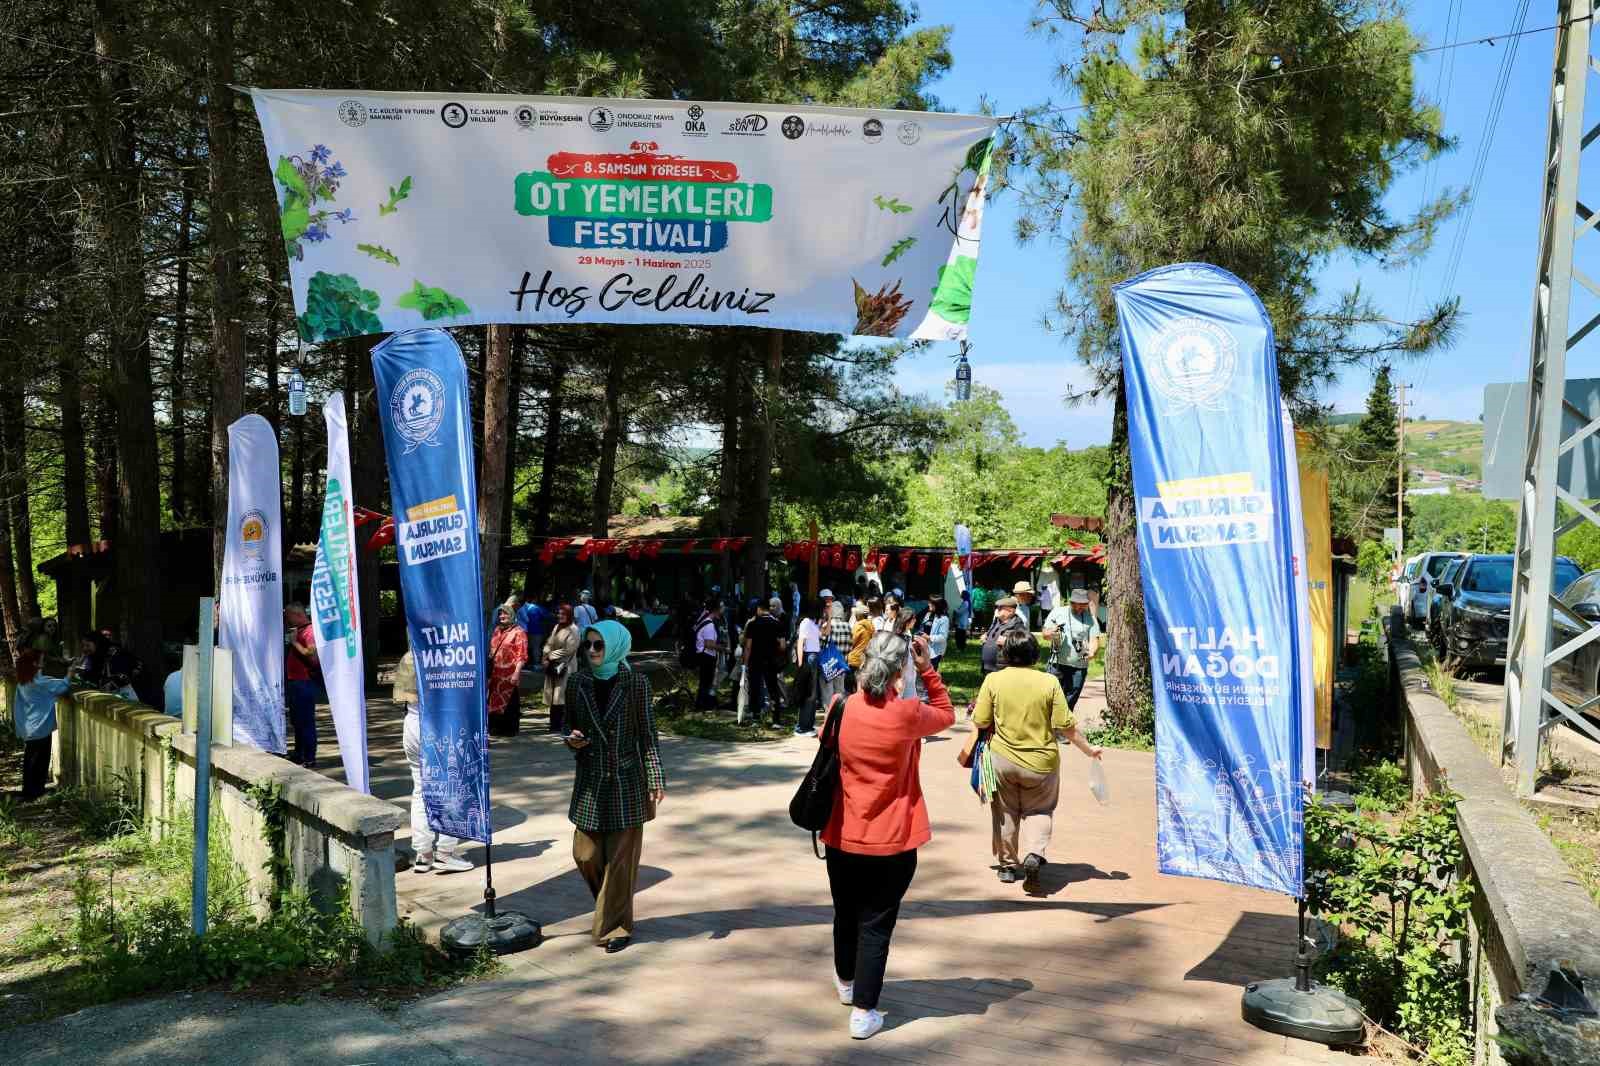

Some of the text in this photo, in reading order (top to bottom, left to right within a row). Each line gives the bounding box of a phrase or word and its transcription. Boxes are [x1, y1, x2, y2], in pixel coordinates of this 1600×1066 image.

[539, 114, 583, 122] BÜYÜKŞEHİR
[617, 113, 653, 121] ONDOKUZ
[617, 119, 663, 128] ÜNİVERSİTESİ
[685, 120, 706, 132] OKA
[651, 163, 704, 177] YÖRESEL
[530, 181, 754, 216] OT YEMEKLERİ
[574, 217, 712, 248] FESTİVALİ
[578, 256, 592, 265] 29
[594, 257, 625, 268] Mayıs
[636, 258, 641, 267] 1
[643, 258, 681, 269] Haziran
[683, 259, 712, 269] 2025
[510, 270, 775, 318] Hoş Geldiniz
